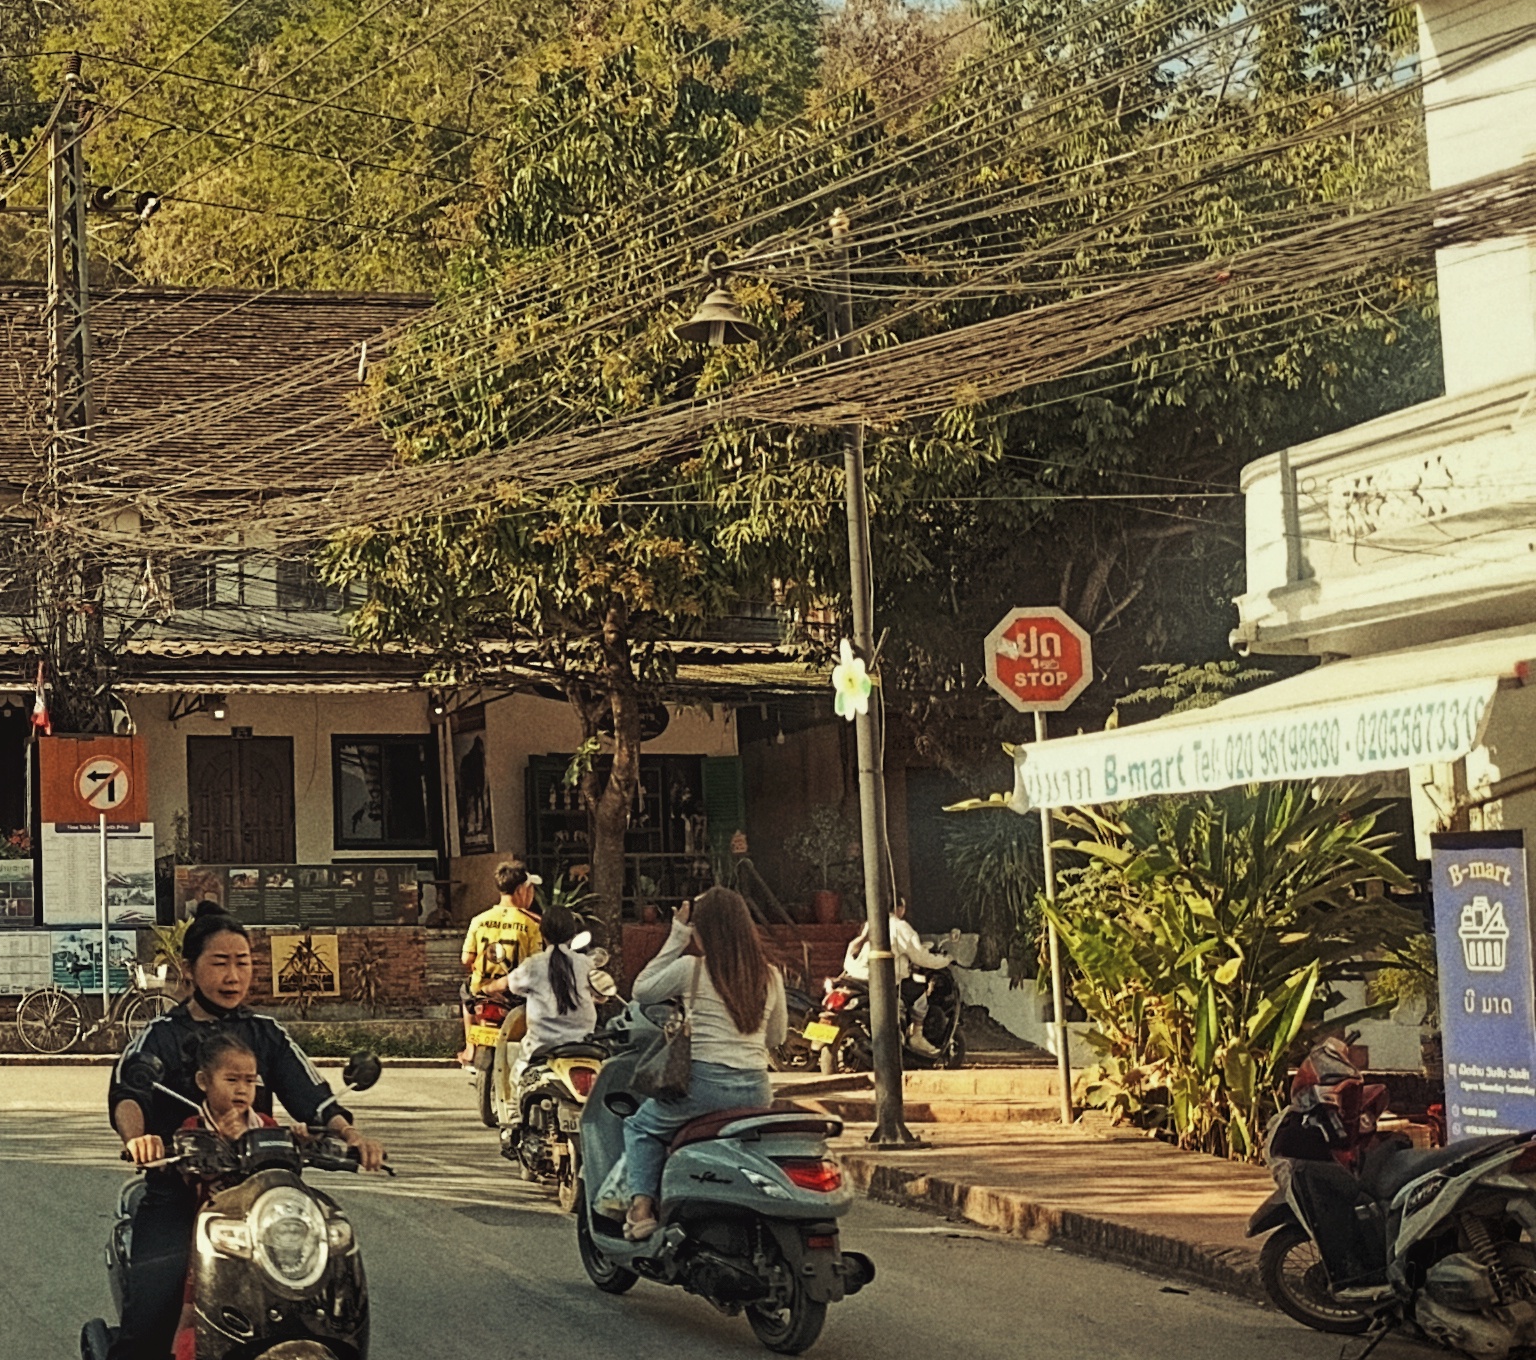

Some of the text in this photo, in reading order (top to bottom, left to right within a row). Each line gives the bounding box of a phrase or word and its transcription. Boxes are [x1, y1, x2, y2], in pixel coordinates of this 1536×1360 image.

[1014, 671, 1068, 687] STOP
[1104, 745, 1186, 796] B-mart
[1224, 731, 1254, 780] 020
[1258, 718, 1340, 776] 96198680
[1448, 861, 1512, 887] B-mart
